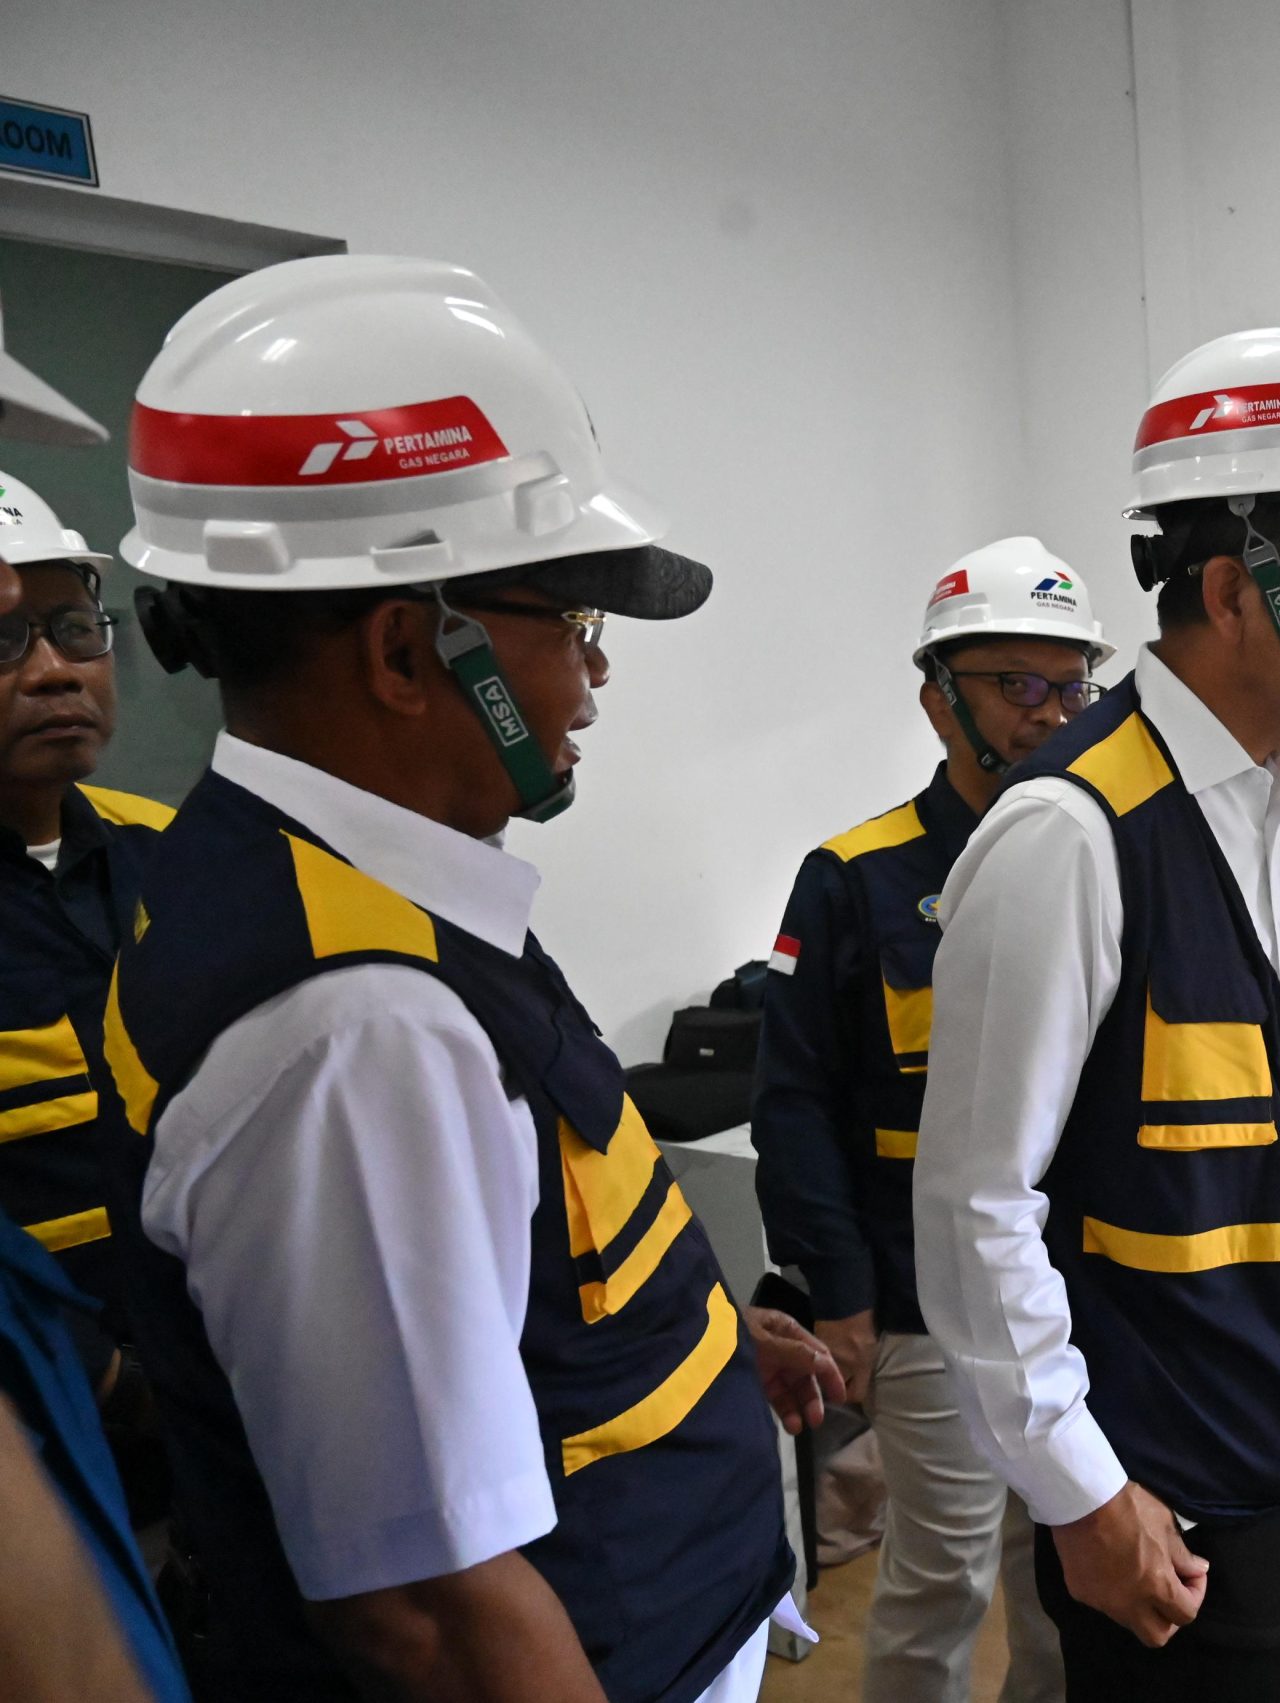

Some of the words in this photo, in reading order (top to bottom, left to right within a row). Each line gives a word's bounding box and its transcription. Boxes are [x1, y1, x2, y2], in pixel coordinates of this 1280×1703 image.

[1242, 415, 1256, 423] GAS
[383, 425, 473, 455] PERTAMINA
[399, 456, 424, 469] GAS
[425, 448, 470, 465] NEGARA
[1030, 591, 1077, 607] PERTAMINA
[485, 684, 520, 737] MSA
